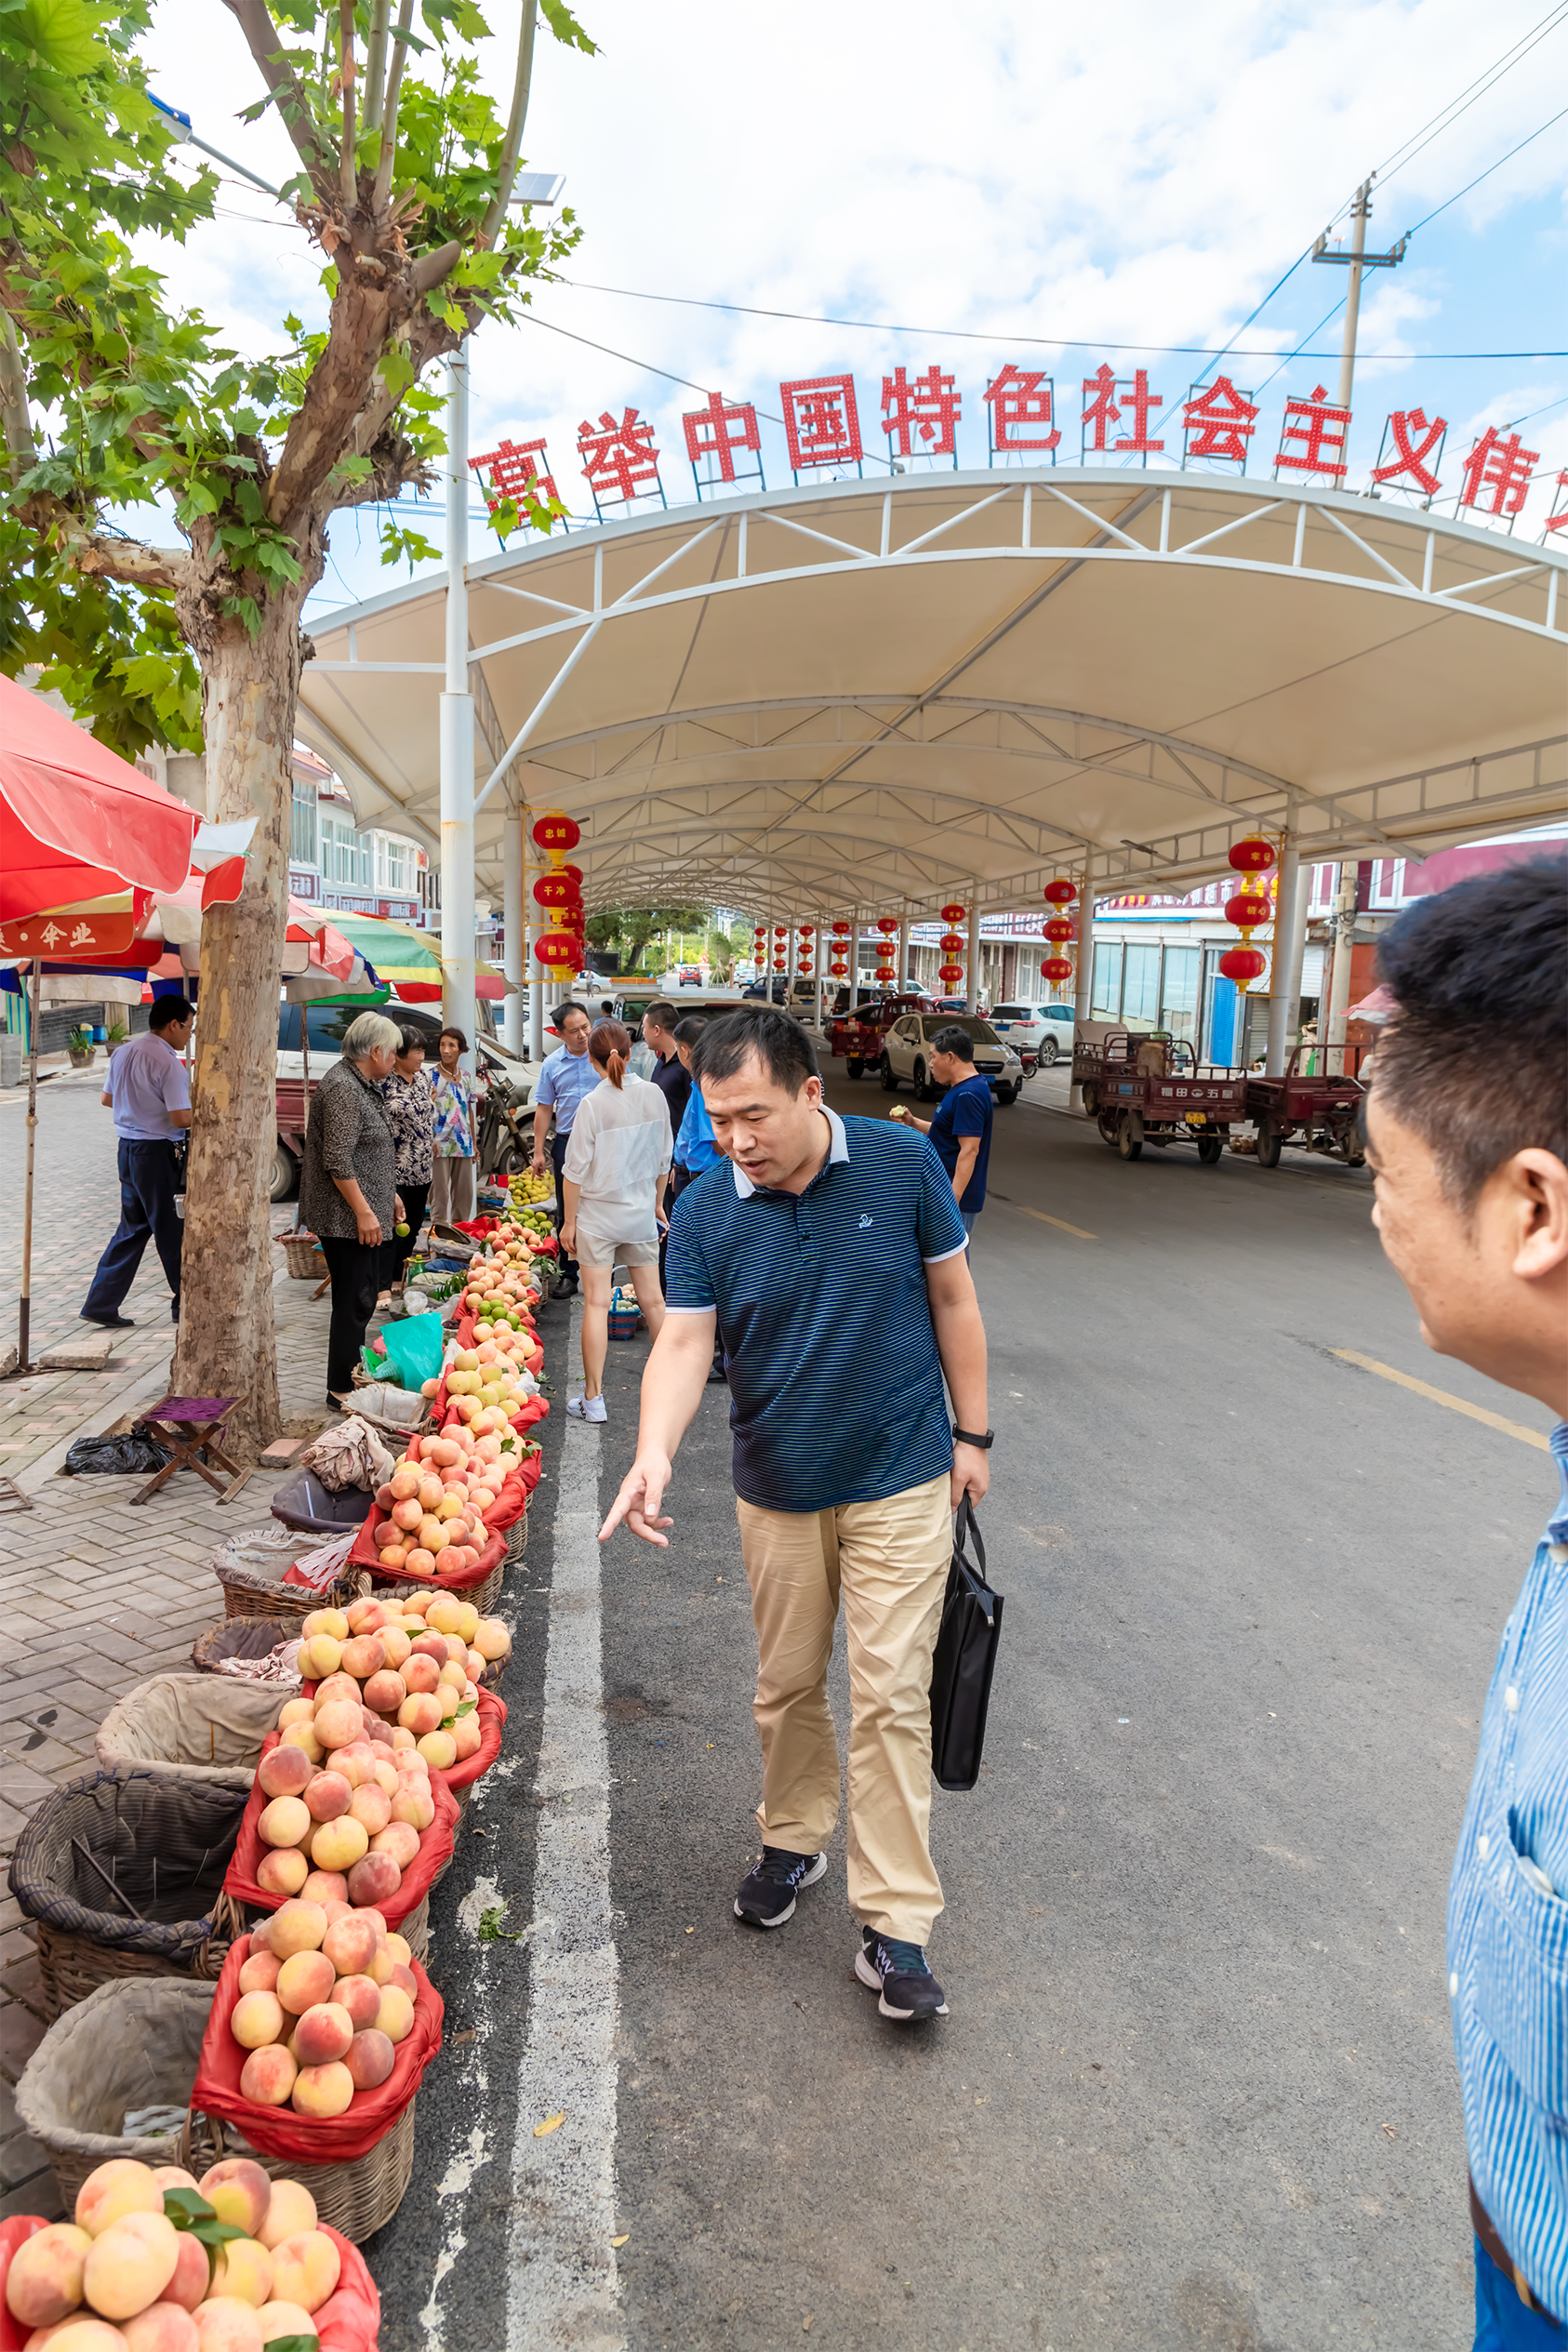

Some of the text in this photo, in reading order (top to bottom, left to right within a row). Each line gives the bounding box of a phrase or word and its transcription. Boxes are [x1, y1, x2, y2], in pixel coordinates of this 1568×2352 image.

[467, 363, 1568, 537] 高举中国特色社会主义伟
[545, 828, 566, 839] 忠诚
[1251, 852, 1271, 862] 牢记
[543, 885, 565, 897] 干净
[1246, 906, 1266, 916] 初心
[548, 945, 569, 957] 担当
[1161, 1087, 1188, 1098] 福田
